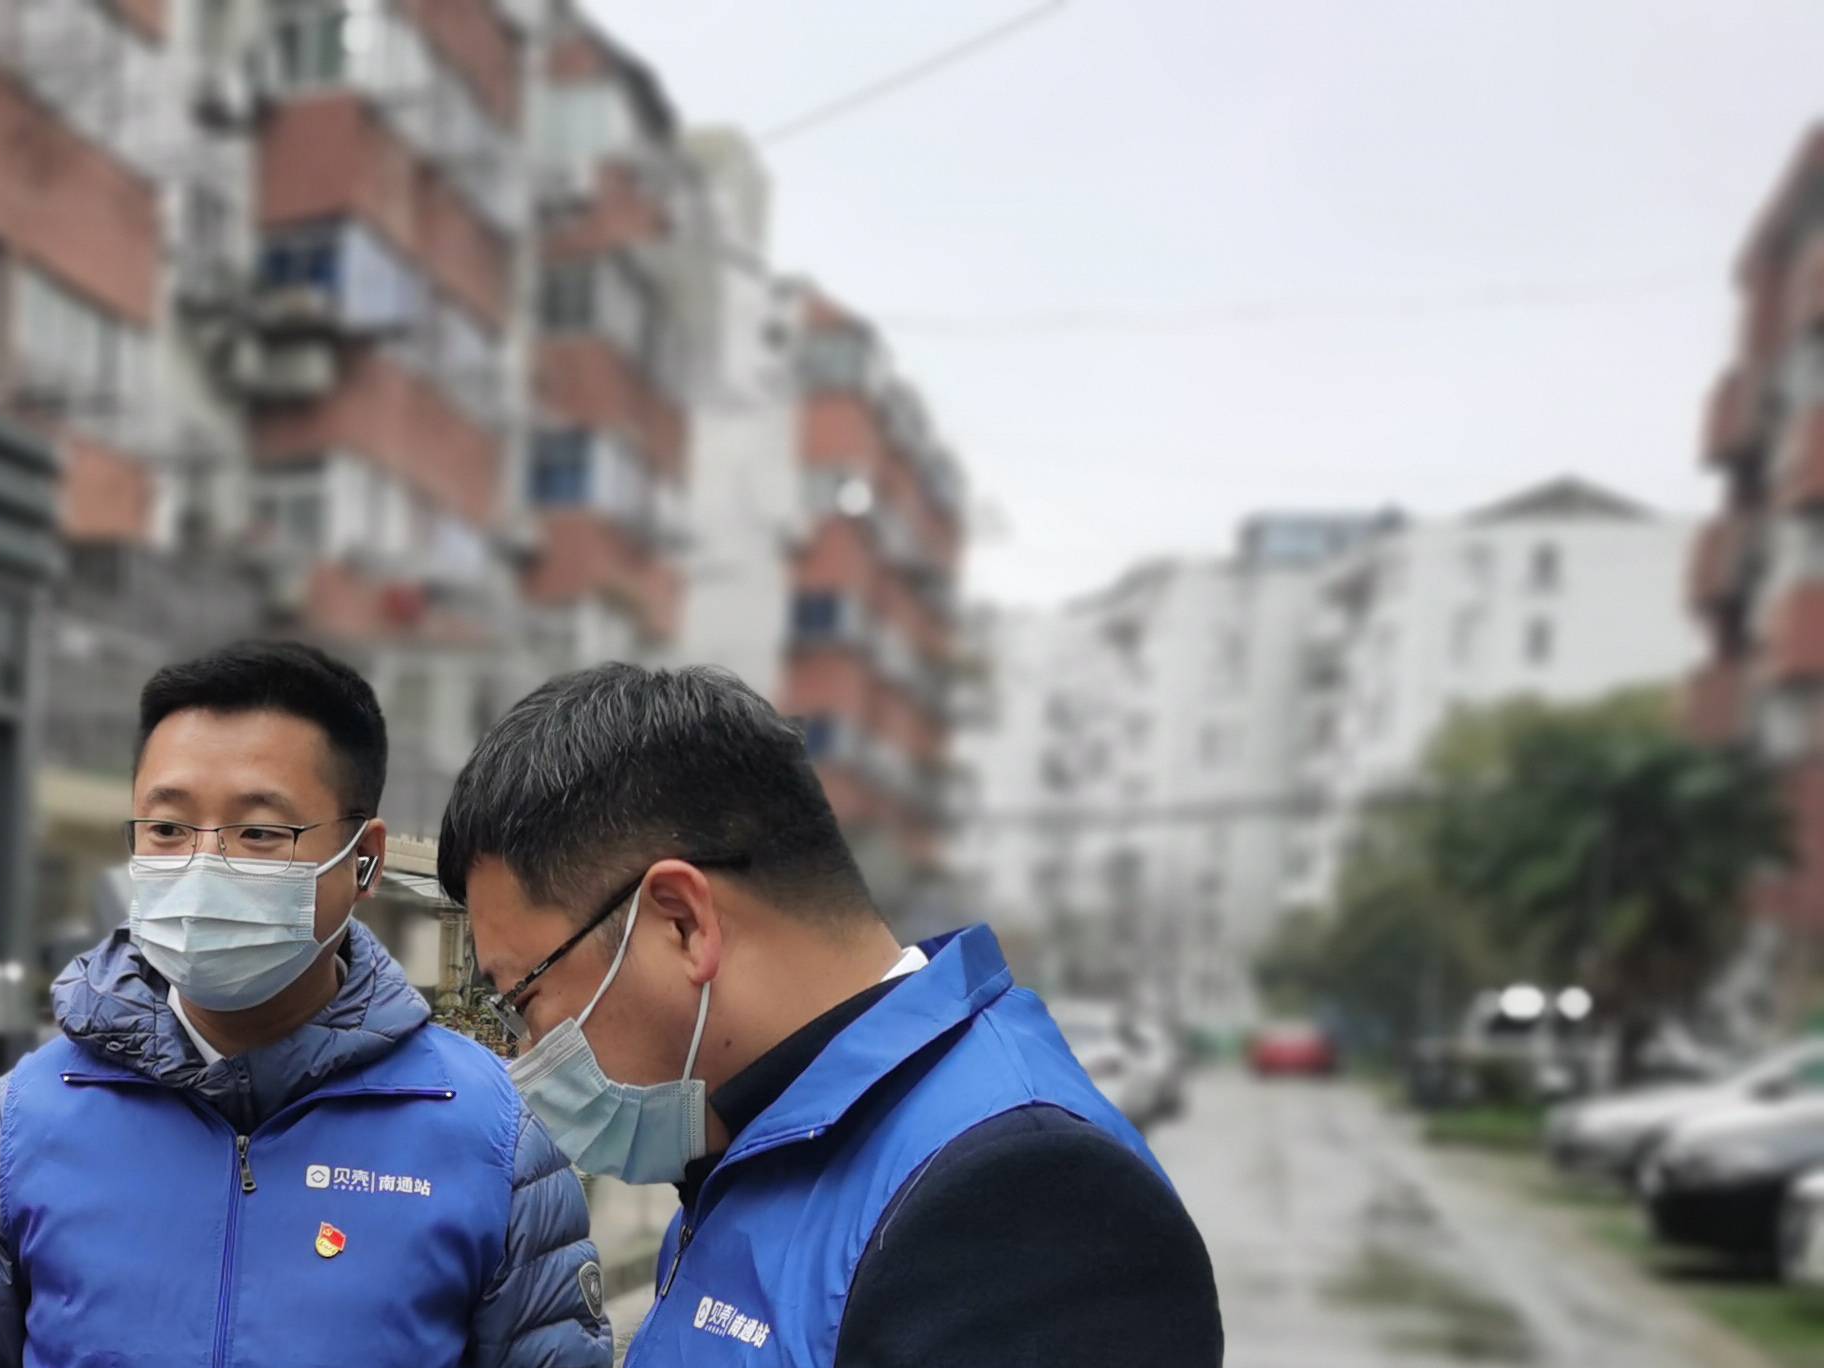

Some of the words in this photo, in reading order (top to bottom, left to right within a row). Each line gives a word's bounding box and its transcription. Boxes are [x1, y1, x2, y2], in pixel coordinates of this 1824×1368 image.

[334, 1167, 370, 1186] 贝壳
[378, 1174, 431, 1196] 南通站
